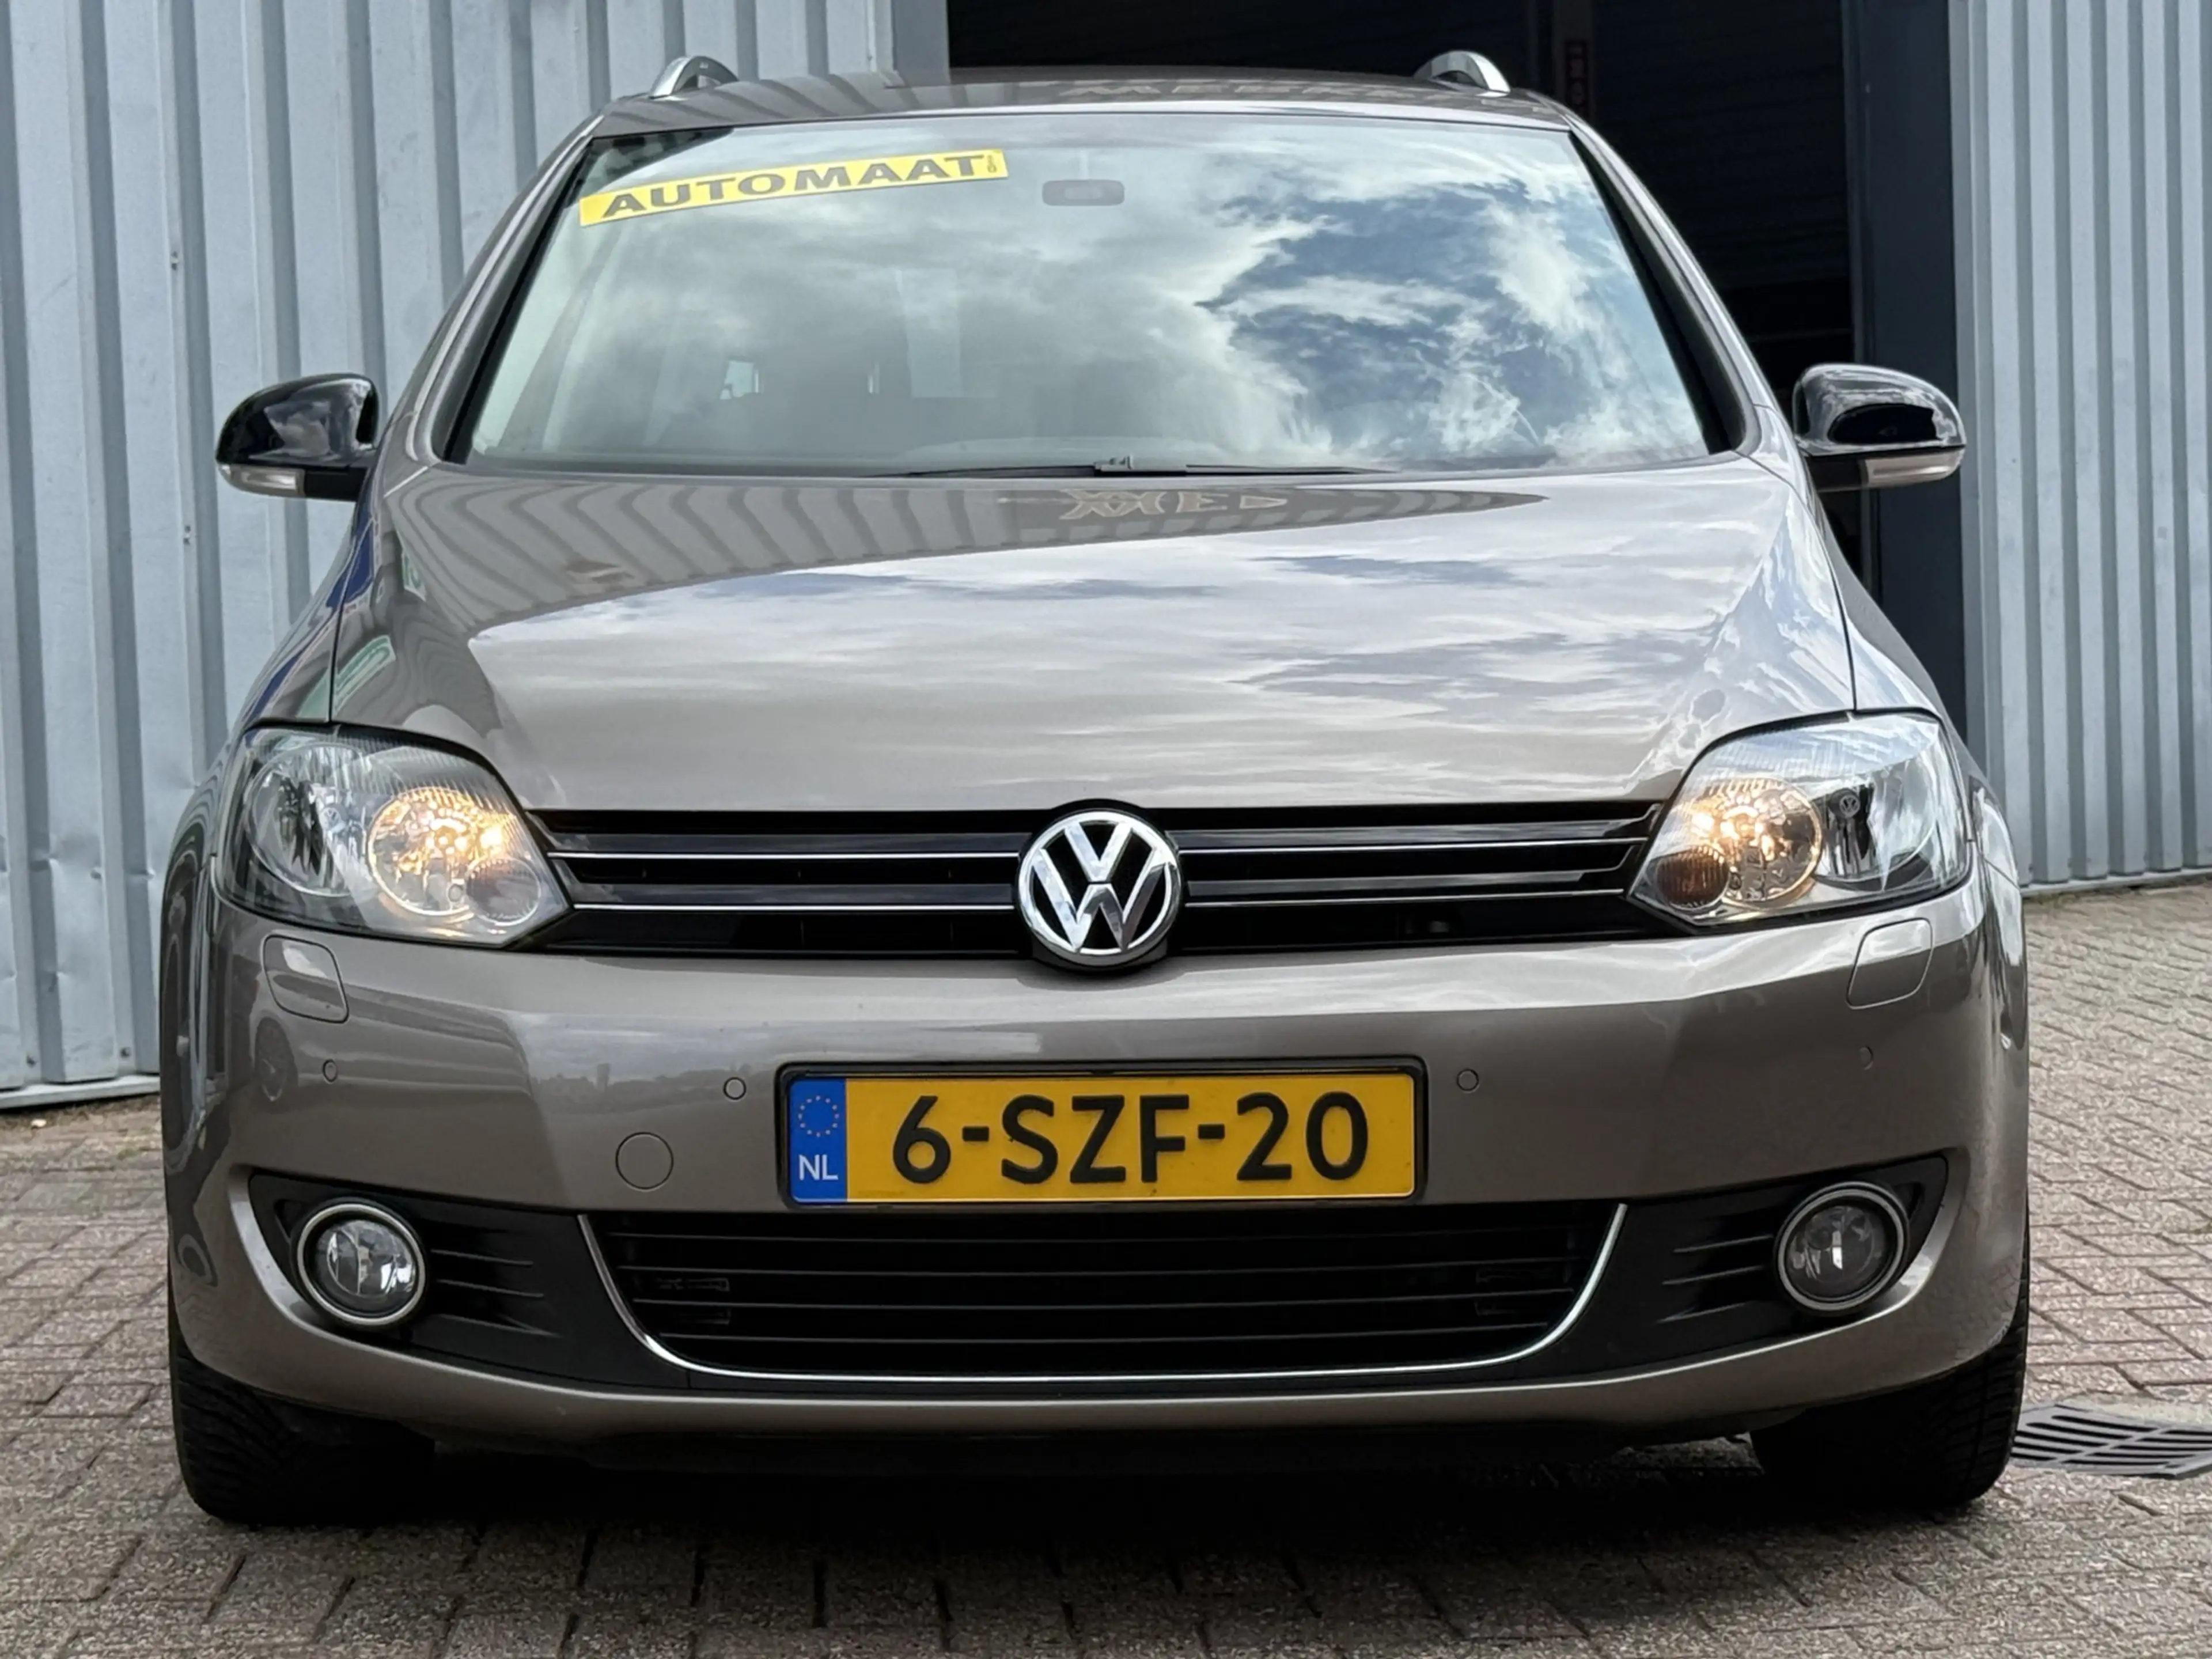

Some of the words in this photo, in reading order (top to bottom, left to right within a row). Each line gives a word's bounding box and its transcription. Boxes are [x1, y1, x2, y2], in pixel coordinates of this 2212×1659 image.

[603, 154, 984, 218] AUTOMAAT
[1024, 815, 1175, 957] VW
[798, 1153, 839, 1181] NL
[892, 1091, 1369, 1185] 6-SZF-20
